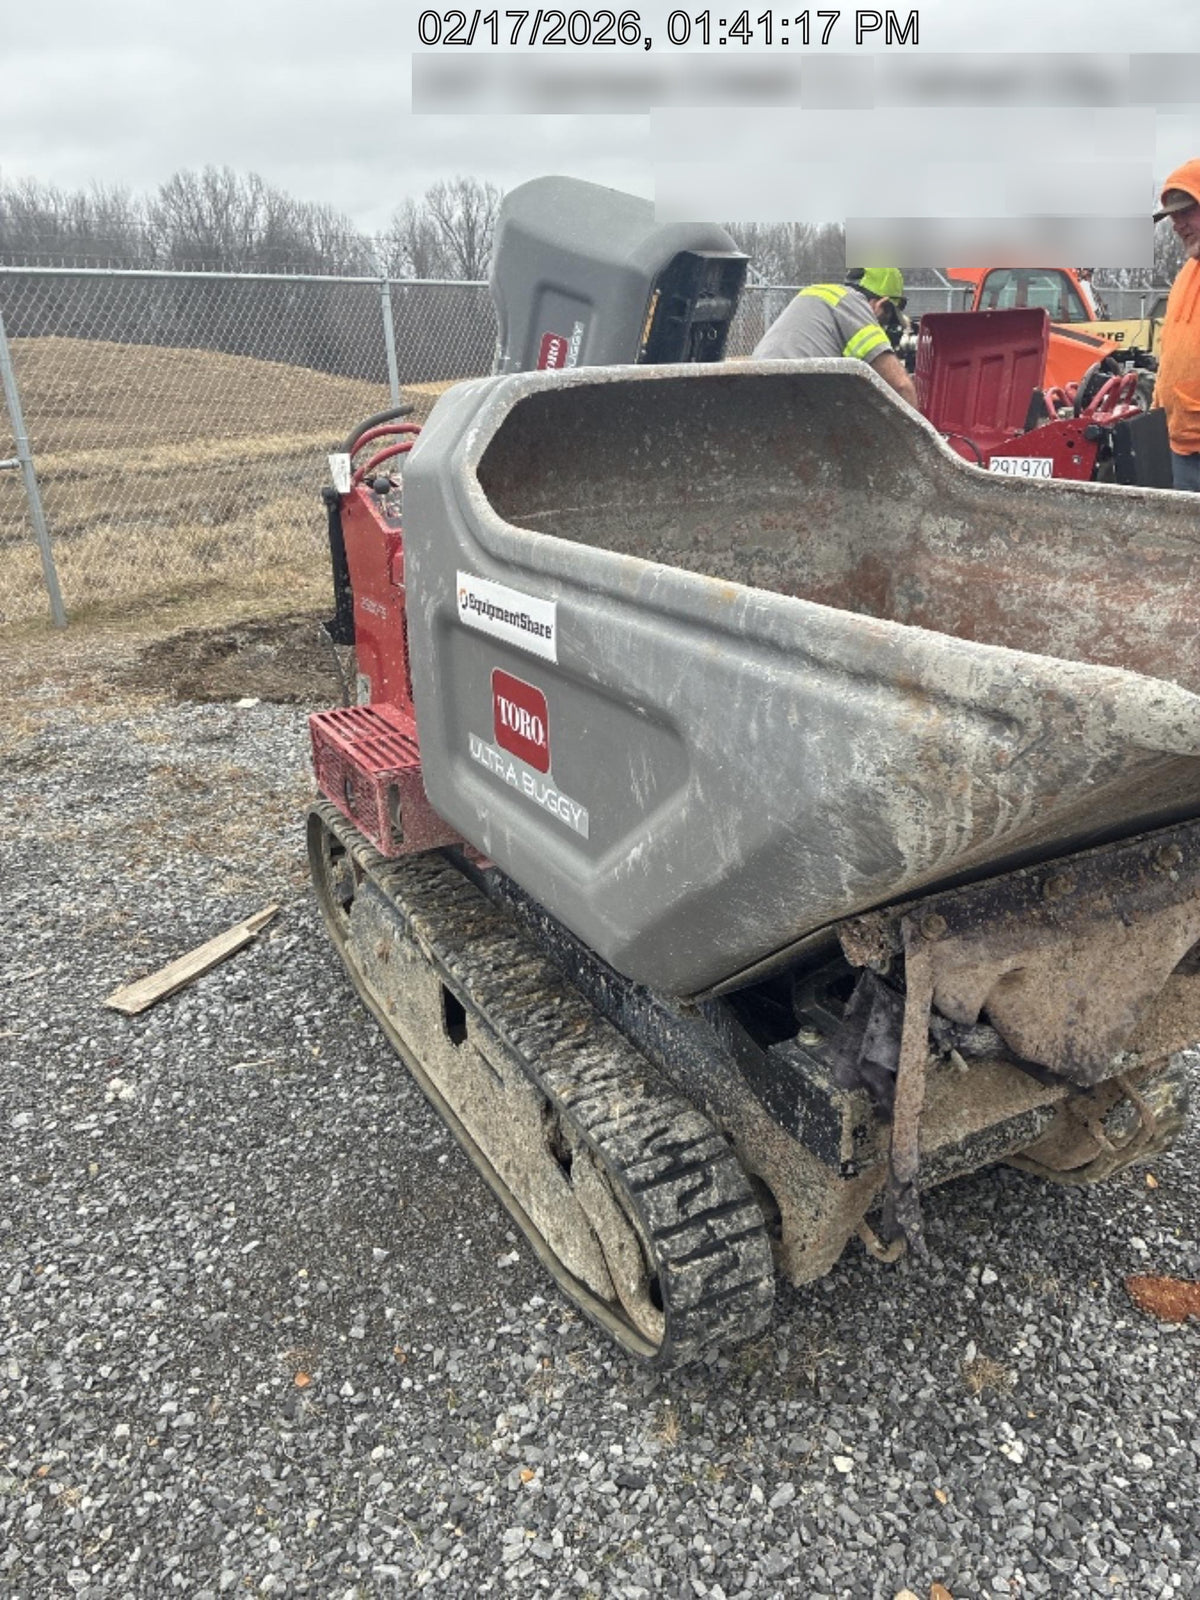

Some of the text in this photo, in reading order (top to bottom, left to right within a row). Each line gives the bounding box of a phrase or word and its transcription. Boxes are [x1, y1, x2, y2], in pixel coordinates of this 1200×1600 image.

[546, 338, 561, 370] ORO
[468, 592, 552, 639] EquipmentShare
[496, 695, 545, 746] TORO
[469, 736, 584, 832] ULTRA BUGGY
